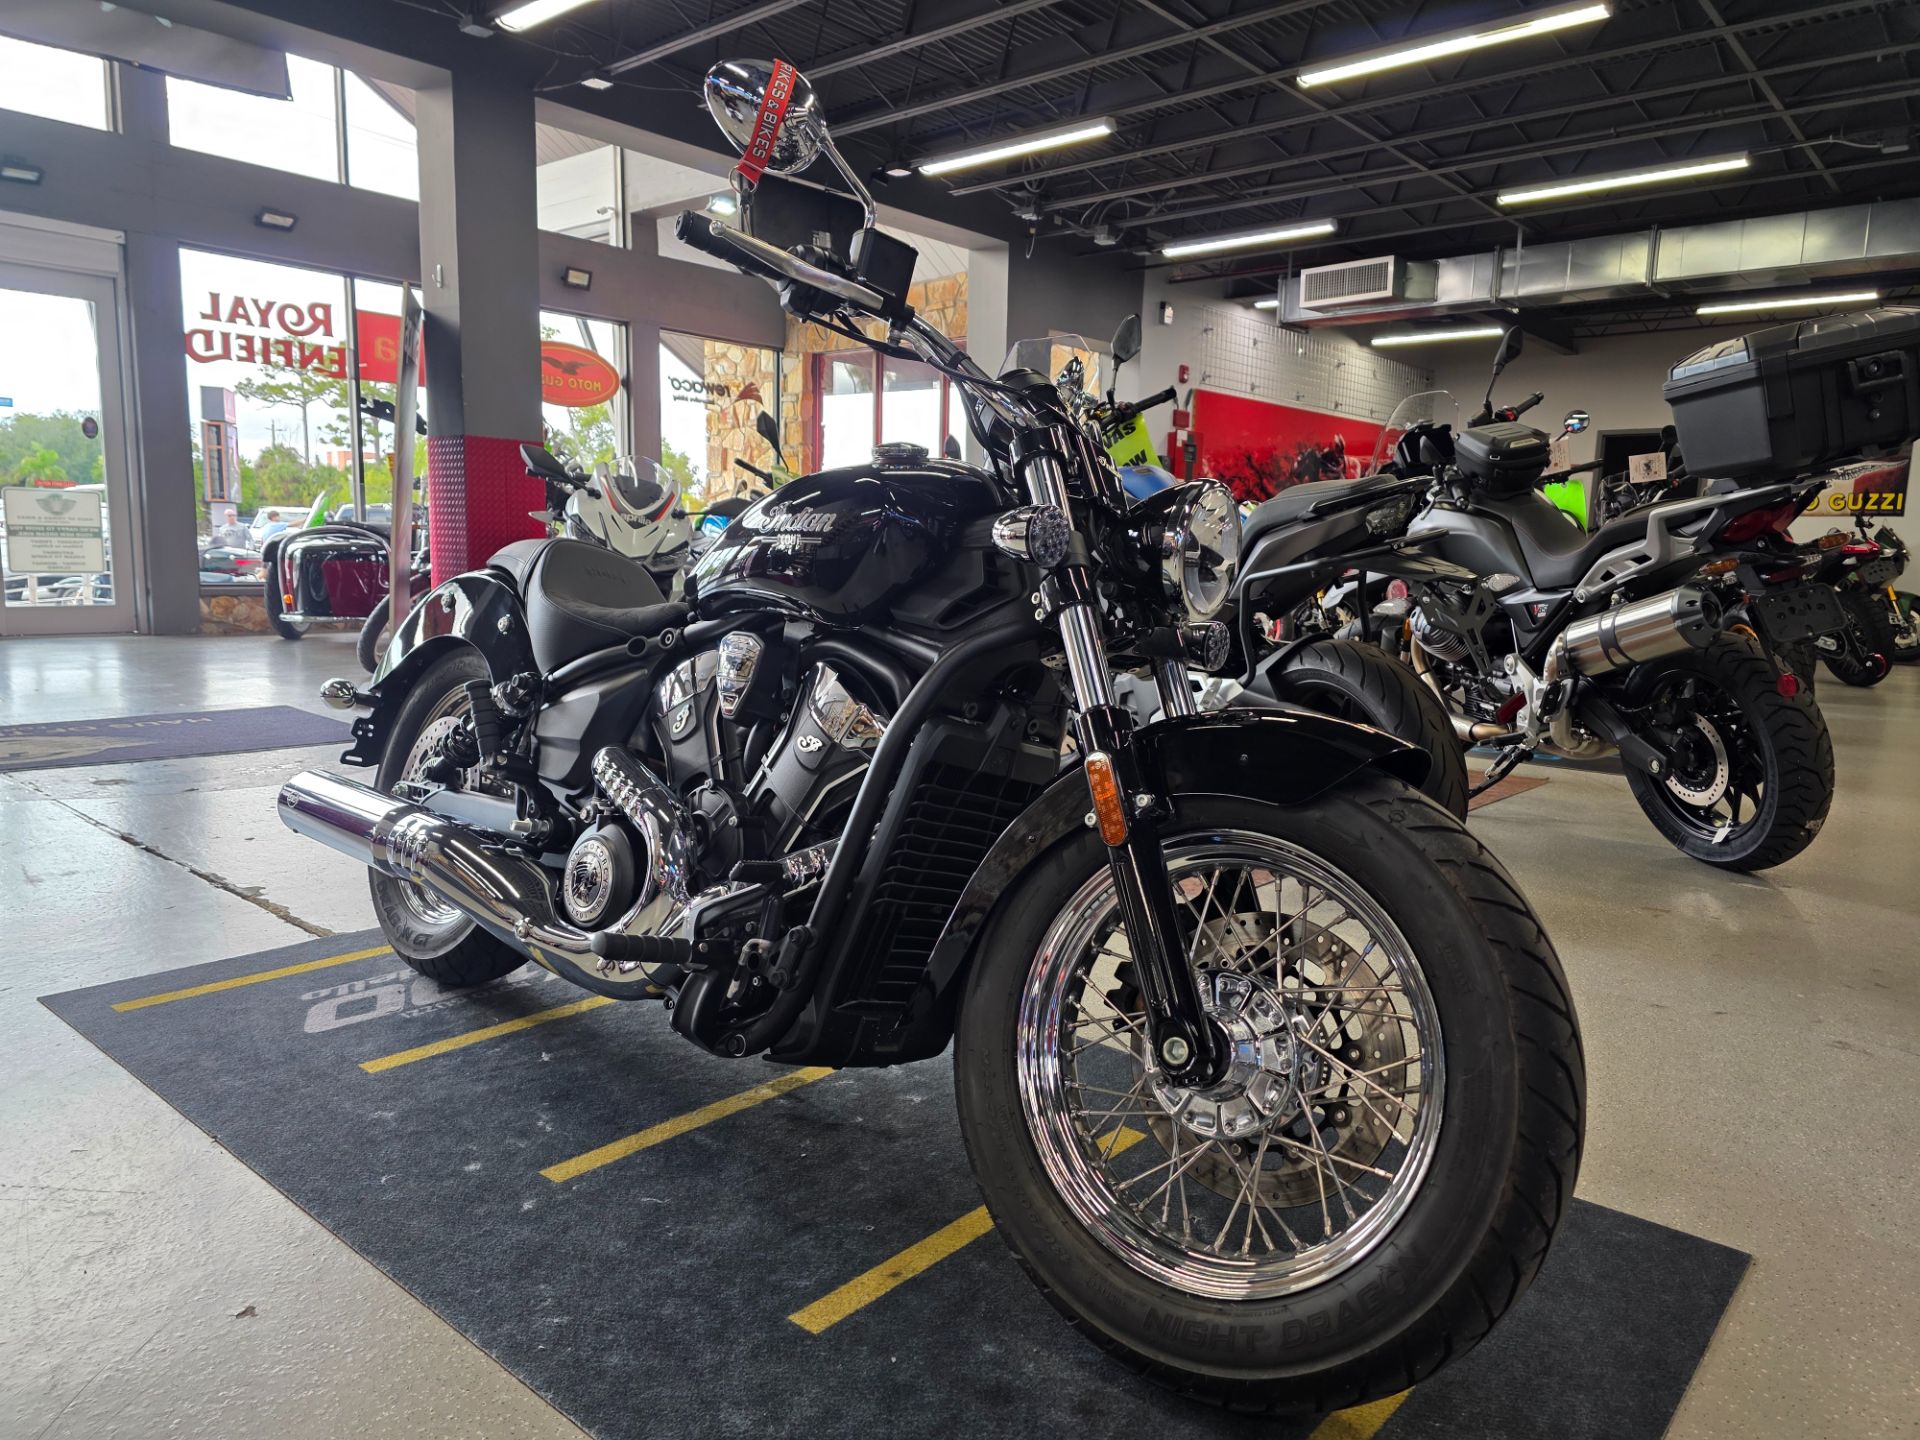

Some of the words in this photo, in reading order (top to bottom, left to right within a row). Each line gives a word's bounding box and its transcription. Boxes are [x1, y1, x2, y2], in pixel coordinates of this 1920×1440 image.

[767, 98, 780, 110] &
[751, 111, 778, 160] BIKES
[1828, 492, 1904, 511] GUZZI
[759, 500, 837, 534] Indian
[777, 533, 802, 547] SCOUT
[1143, 1307, 1264, 1353] NIGHT
[1279, 1256, 1430, 1352] DRAGON
